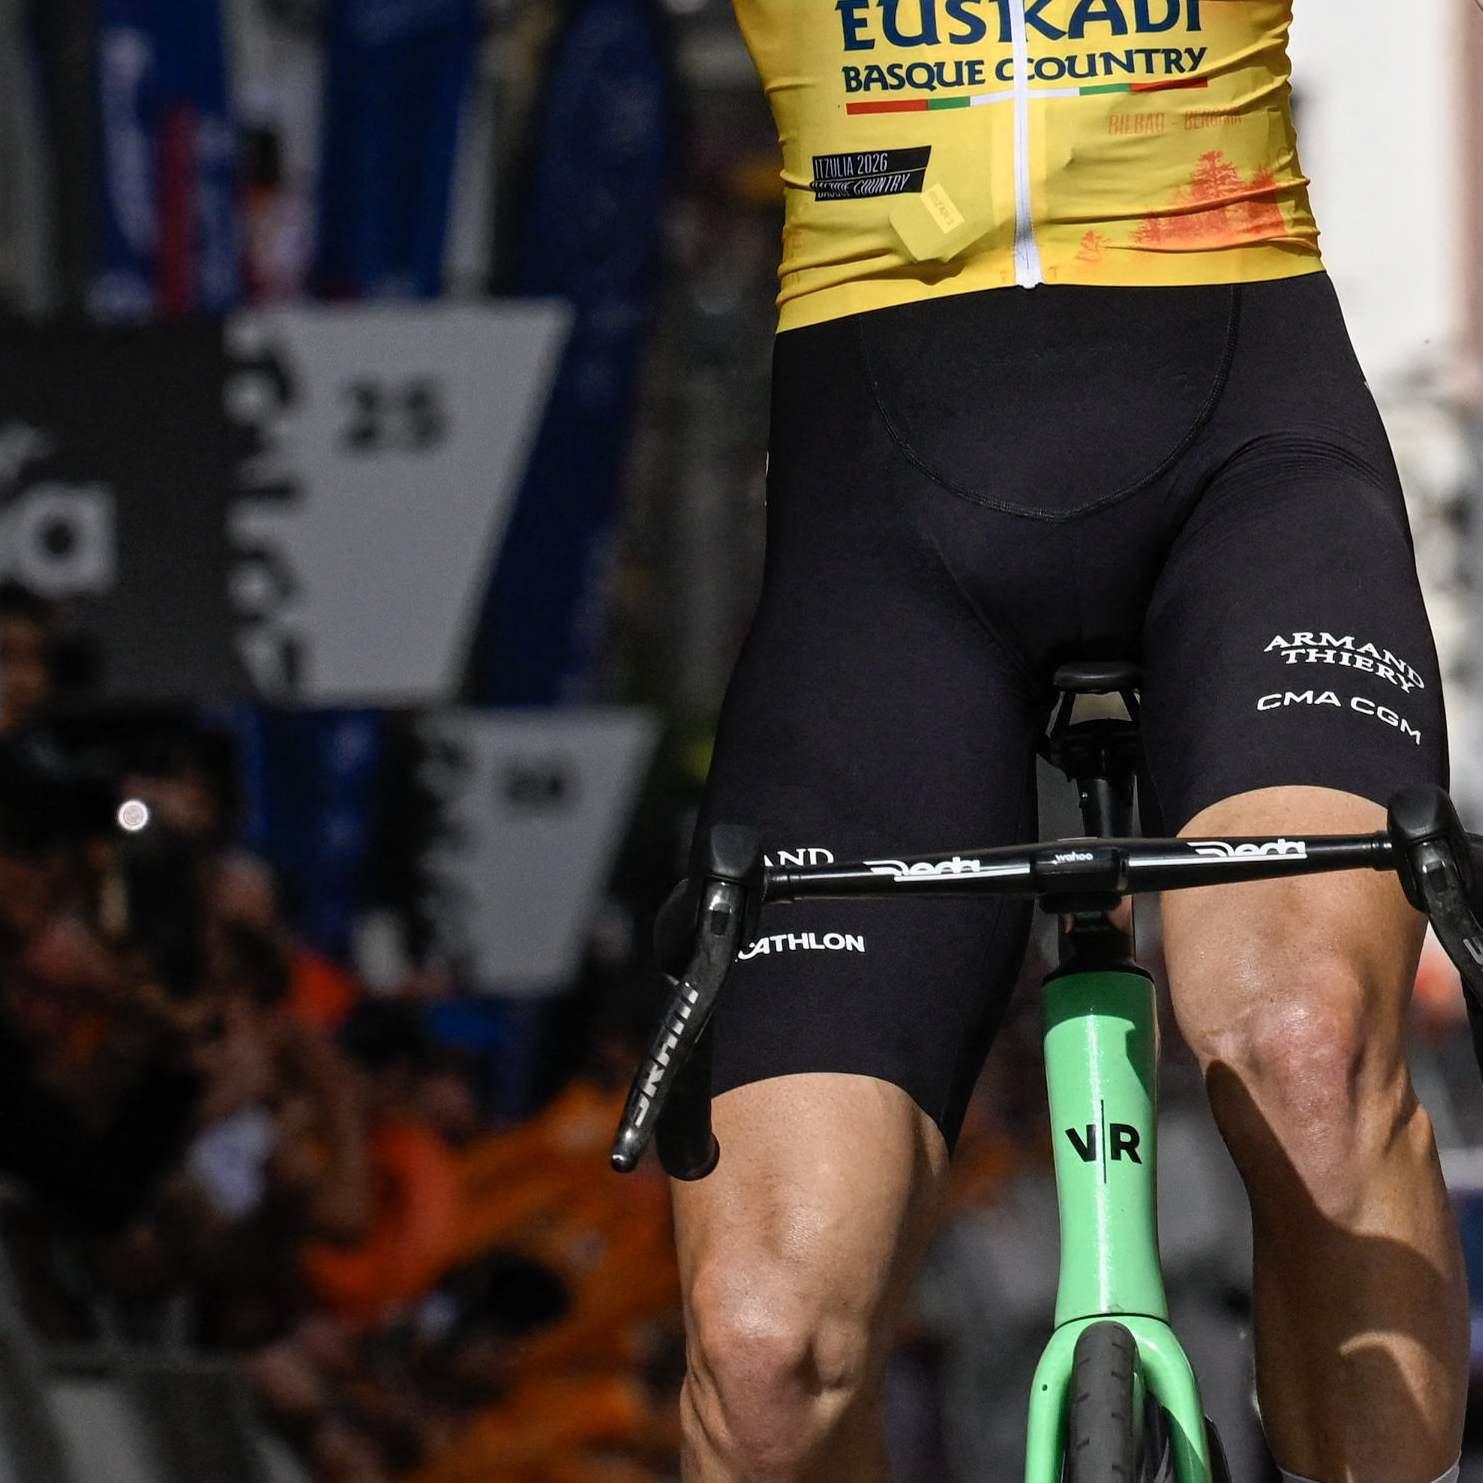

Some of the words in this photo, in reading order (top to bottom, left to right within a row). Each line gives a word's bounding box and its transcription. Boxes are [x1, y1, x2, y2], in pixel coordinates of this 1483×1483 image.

[842, 59, 986, 93] BASQUE
[1108, 112, 1165, 135] BILBAO
[815, 156, 854, 179] ITZULIA
[857, 153, 889, 176] 2026
[853, 173, 911, 196] COUNTRY
[333, 378, 448, 455] 25
[1264, 632, 1425, 689] ARMAND
[1281, 648, 1415, 694] THIERY
[1257, 690, 1341, 711] CMA
[1350, 697, 1422, 746] CGM
[1055, 851, 1093, 863] wahoo
[632, 980, 700, 1128] SRAM
